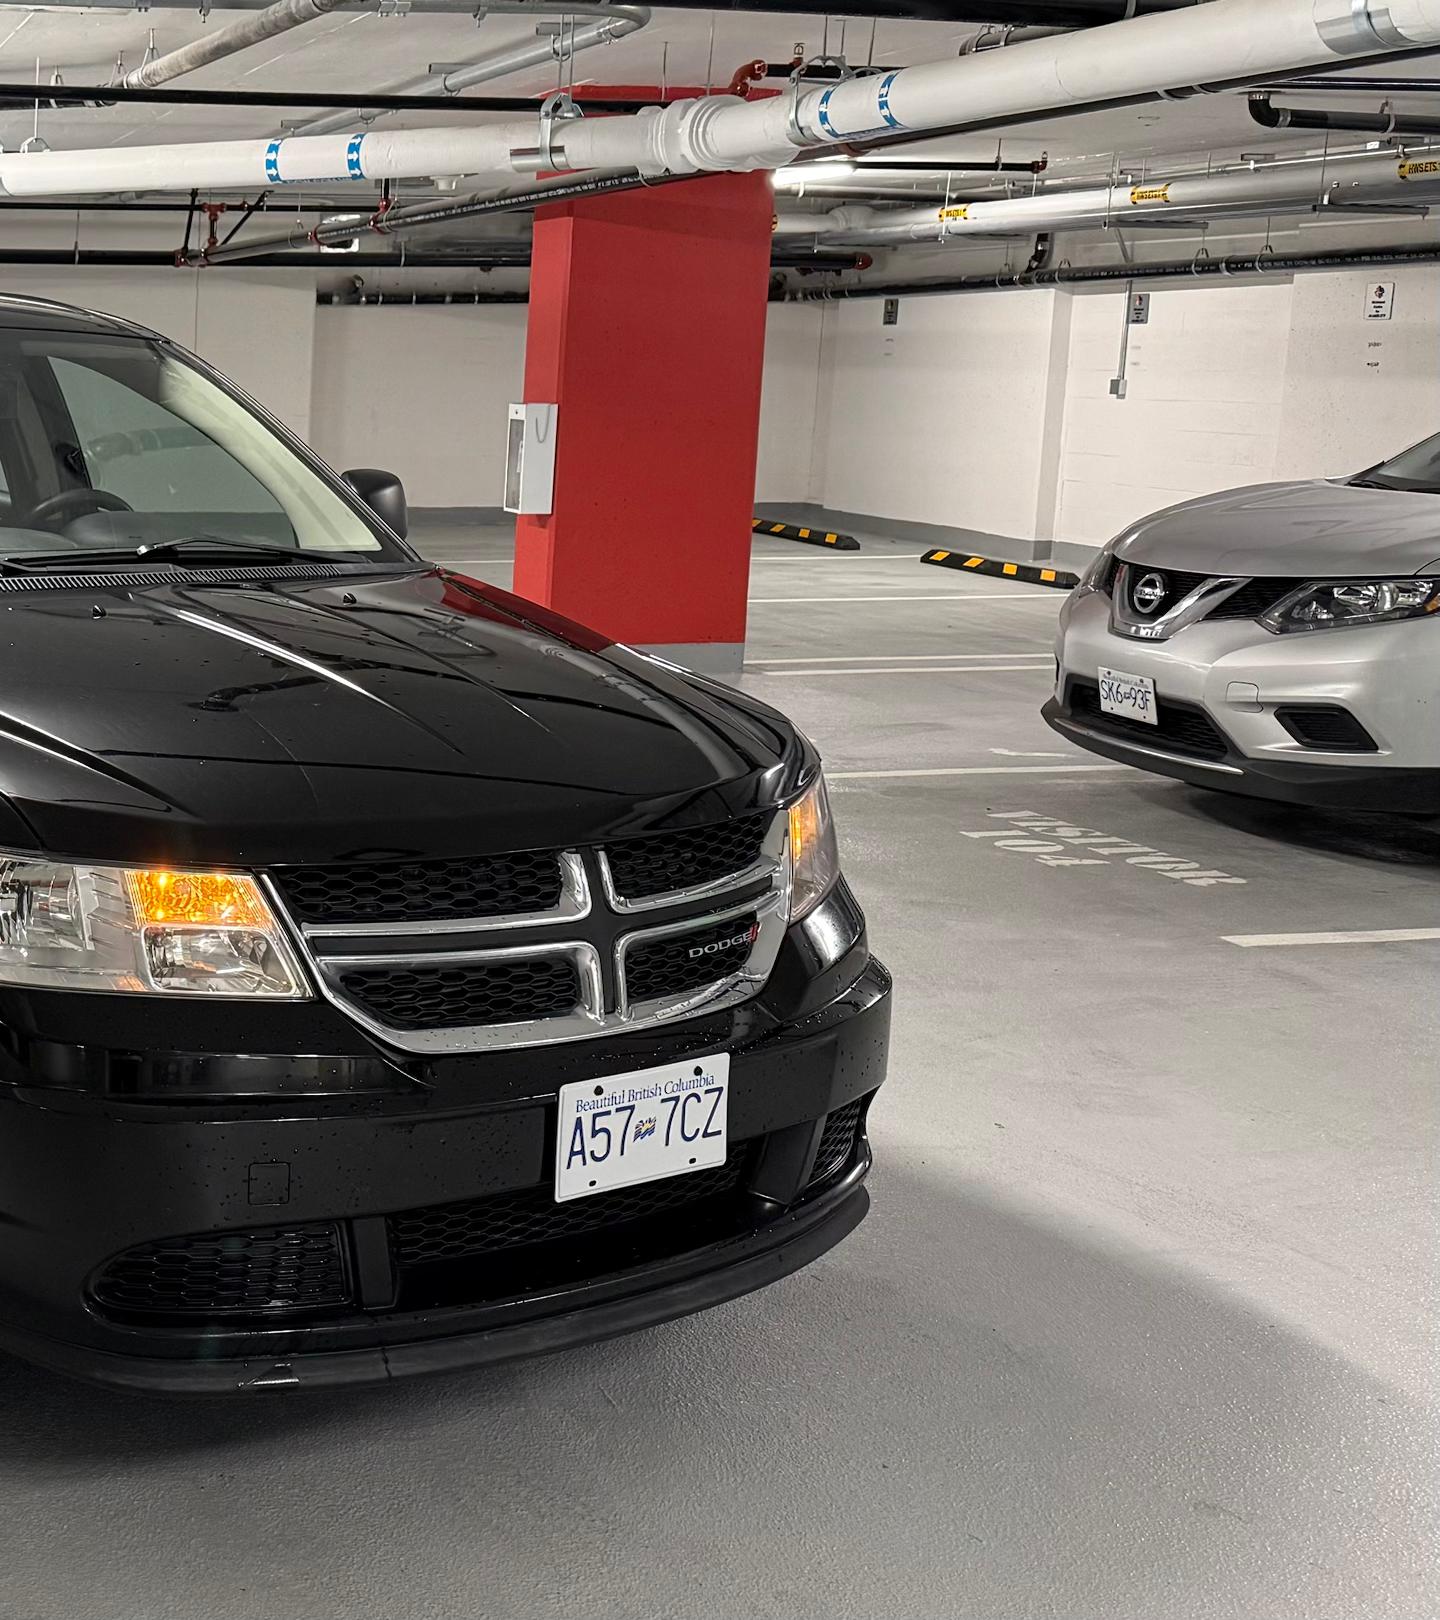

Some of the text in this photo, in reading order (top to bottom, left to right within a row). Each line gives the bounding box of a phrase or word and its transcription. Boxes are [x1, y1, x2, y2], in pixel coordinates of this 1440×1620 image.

[1100, 679, 1124, 704] SK6
[1129, 687, 1152, 712] 93F
[959, 829, 1111, 868] 104
[986, 810, 1248, 887] VISITOR
[688, 931, 753, 958] DODGE
[575, 1073, 715, 1113] Beautiful British Columbia
[566, 1086, 724, 1170] A57 7CZ
